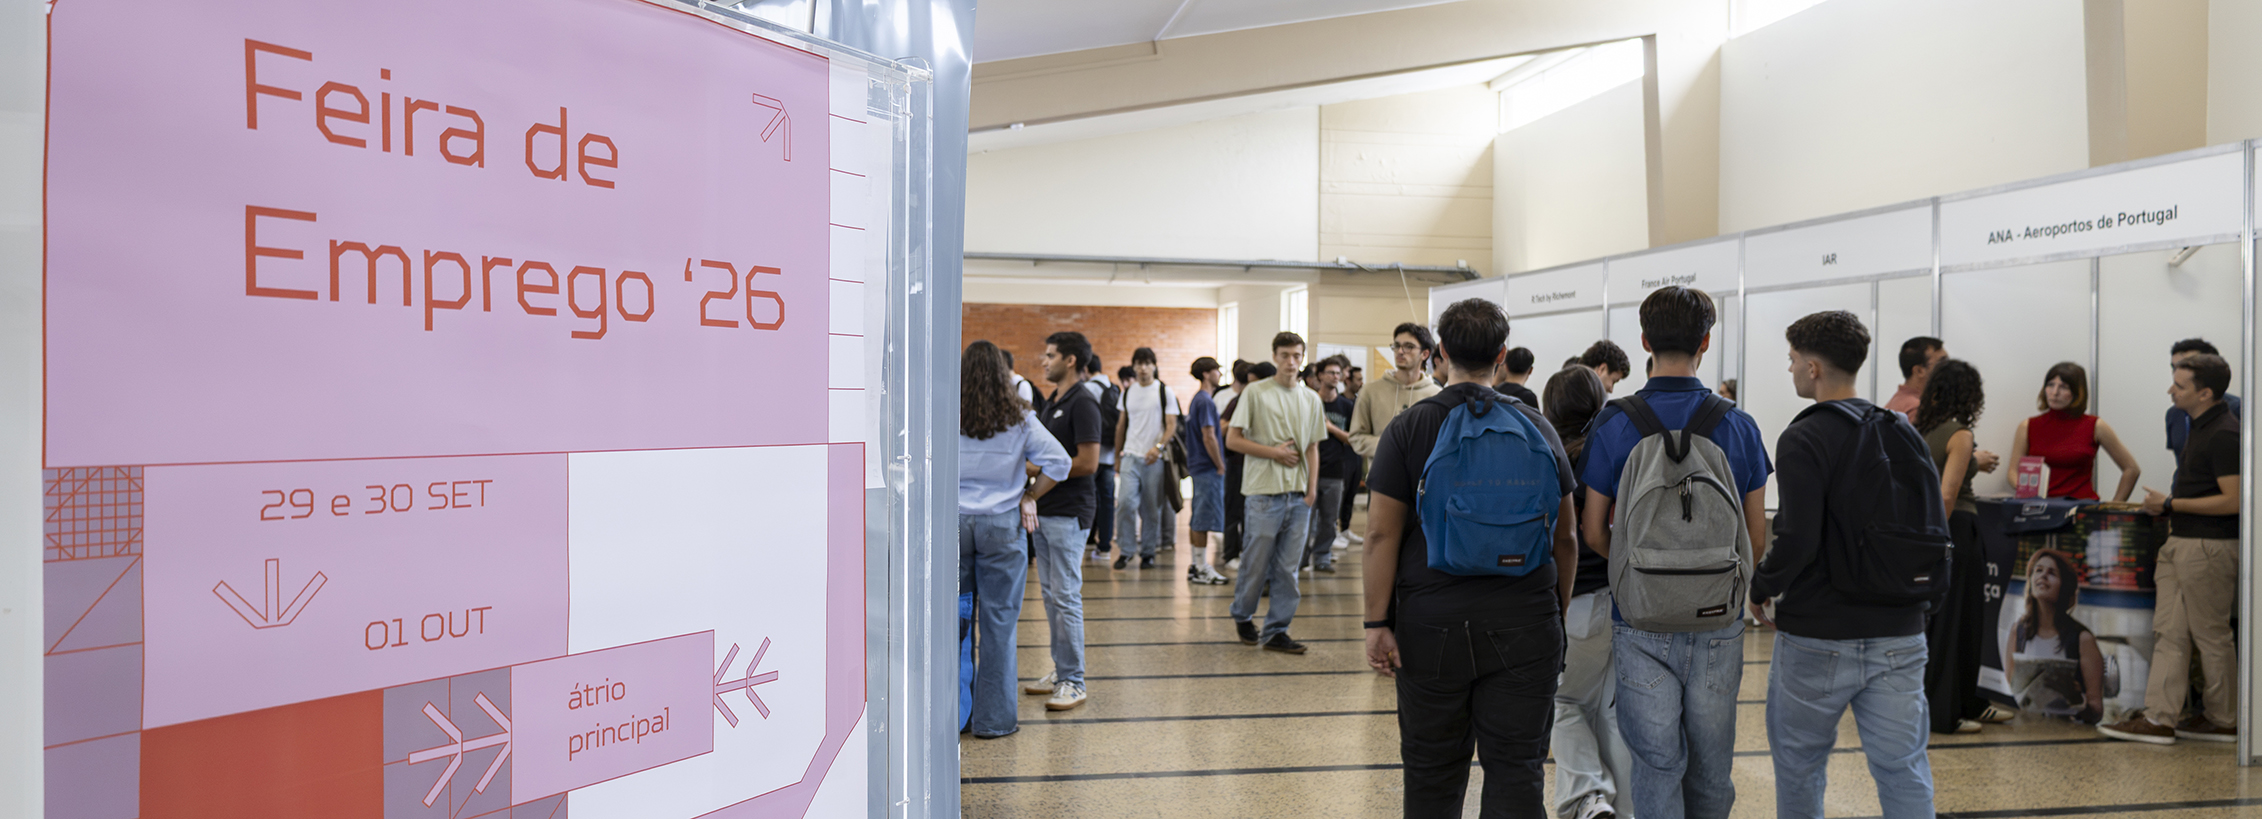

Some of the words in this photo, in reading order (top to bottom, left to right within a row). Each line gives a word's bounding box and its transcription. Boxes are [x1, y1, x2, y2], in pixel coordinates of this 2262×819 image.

[245, 38, 485, 169] Feira
[525, 107, 619, 190] de
[1987, 228, 2014, 245] ANA
[2023, 219, 2094, 240] Aeroportos
[2097, 214, 2114, 229] de
[2117, 204, 2178, 227] Portugal
[245, 205, 656, 341] Emprego
[1641, 279, 1661, 289] France
[1661, 276, 1671, 286] Air
[1671, 272, 1697, 286] Portugal
[1822, 253, 1838, 266] IAR
[260, 488, 315, 522] 29
[331, 495, 351, 517] e
[365, 484, 414, 515] 30
[428, 479, 494, 511] SET
[365, 618, 410, 652] 01
[421, 606, 493, 644] OUT
[568, 677, 626, 711] átrio
[568, 706, 669, 762] principal
